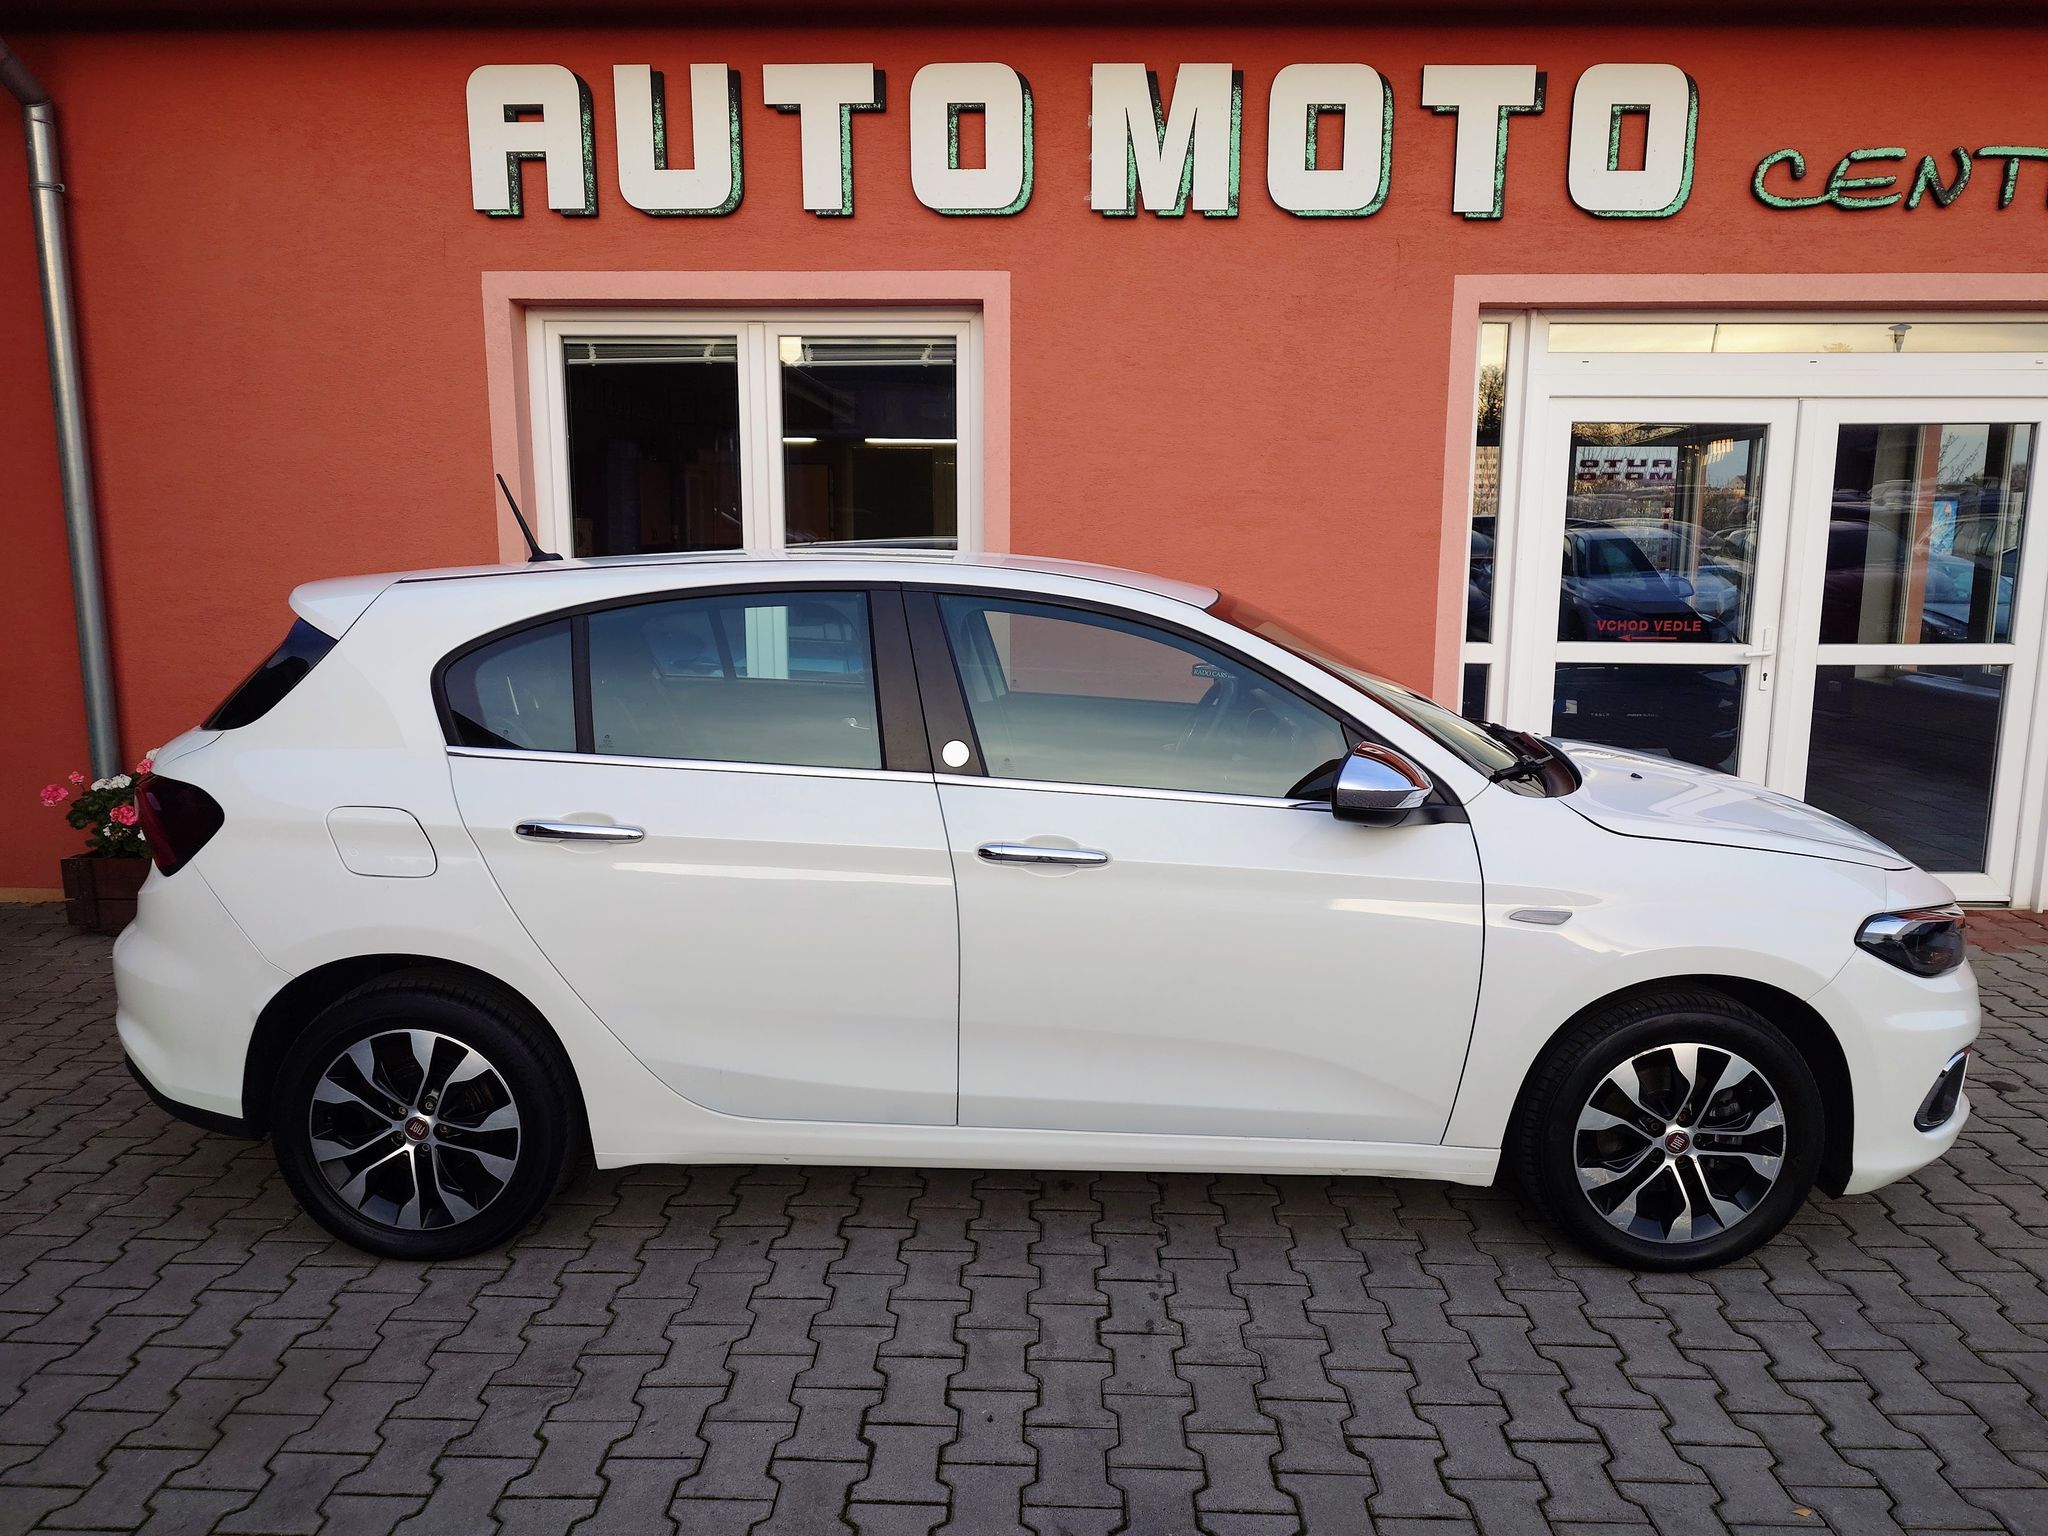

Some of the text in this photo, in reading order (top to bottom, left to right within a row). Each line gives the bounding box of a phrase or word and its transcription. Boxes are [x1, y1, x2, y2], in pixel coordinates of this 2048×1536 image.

[466, 62, 1699, 218] AUTO MOTO
[1750, 146, 2048, 210] CENT
[1597, 619, 1702, 632] VCHOD VEDLE
[410, 1121, 425, 1136] FIAT
[1670, 1135, 1685, 1150] FIAT
